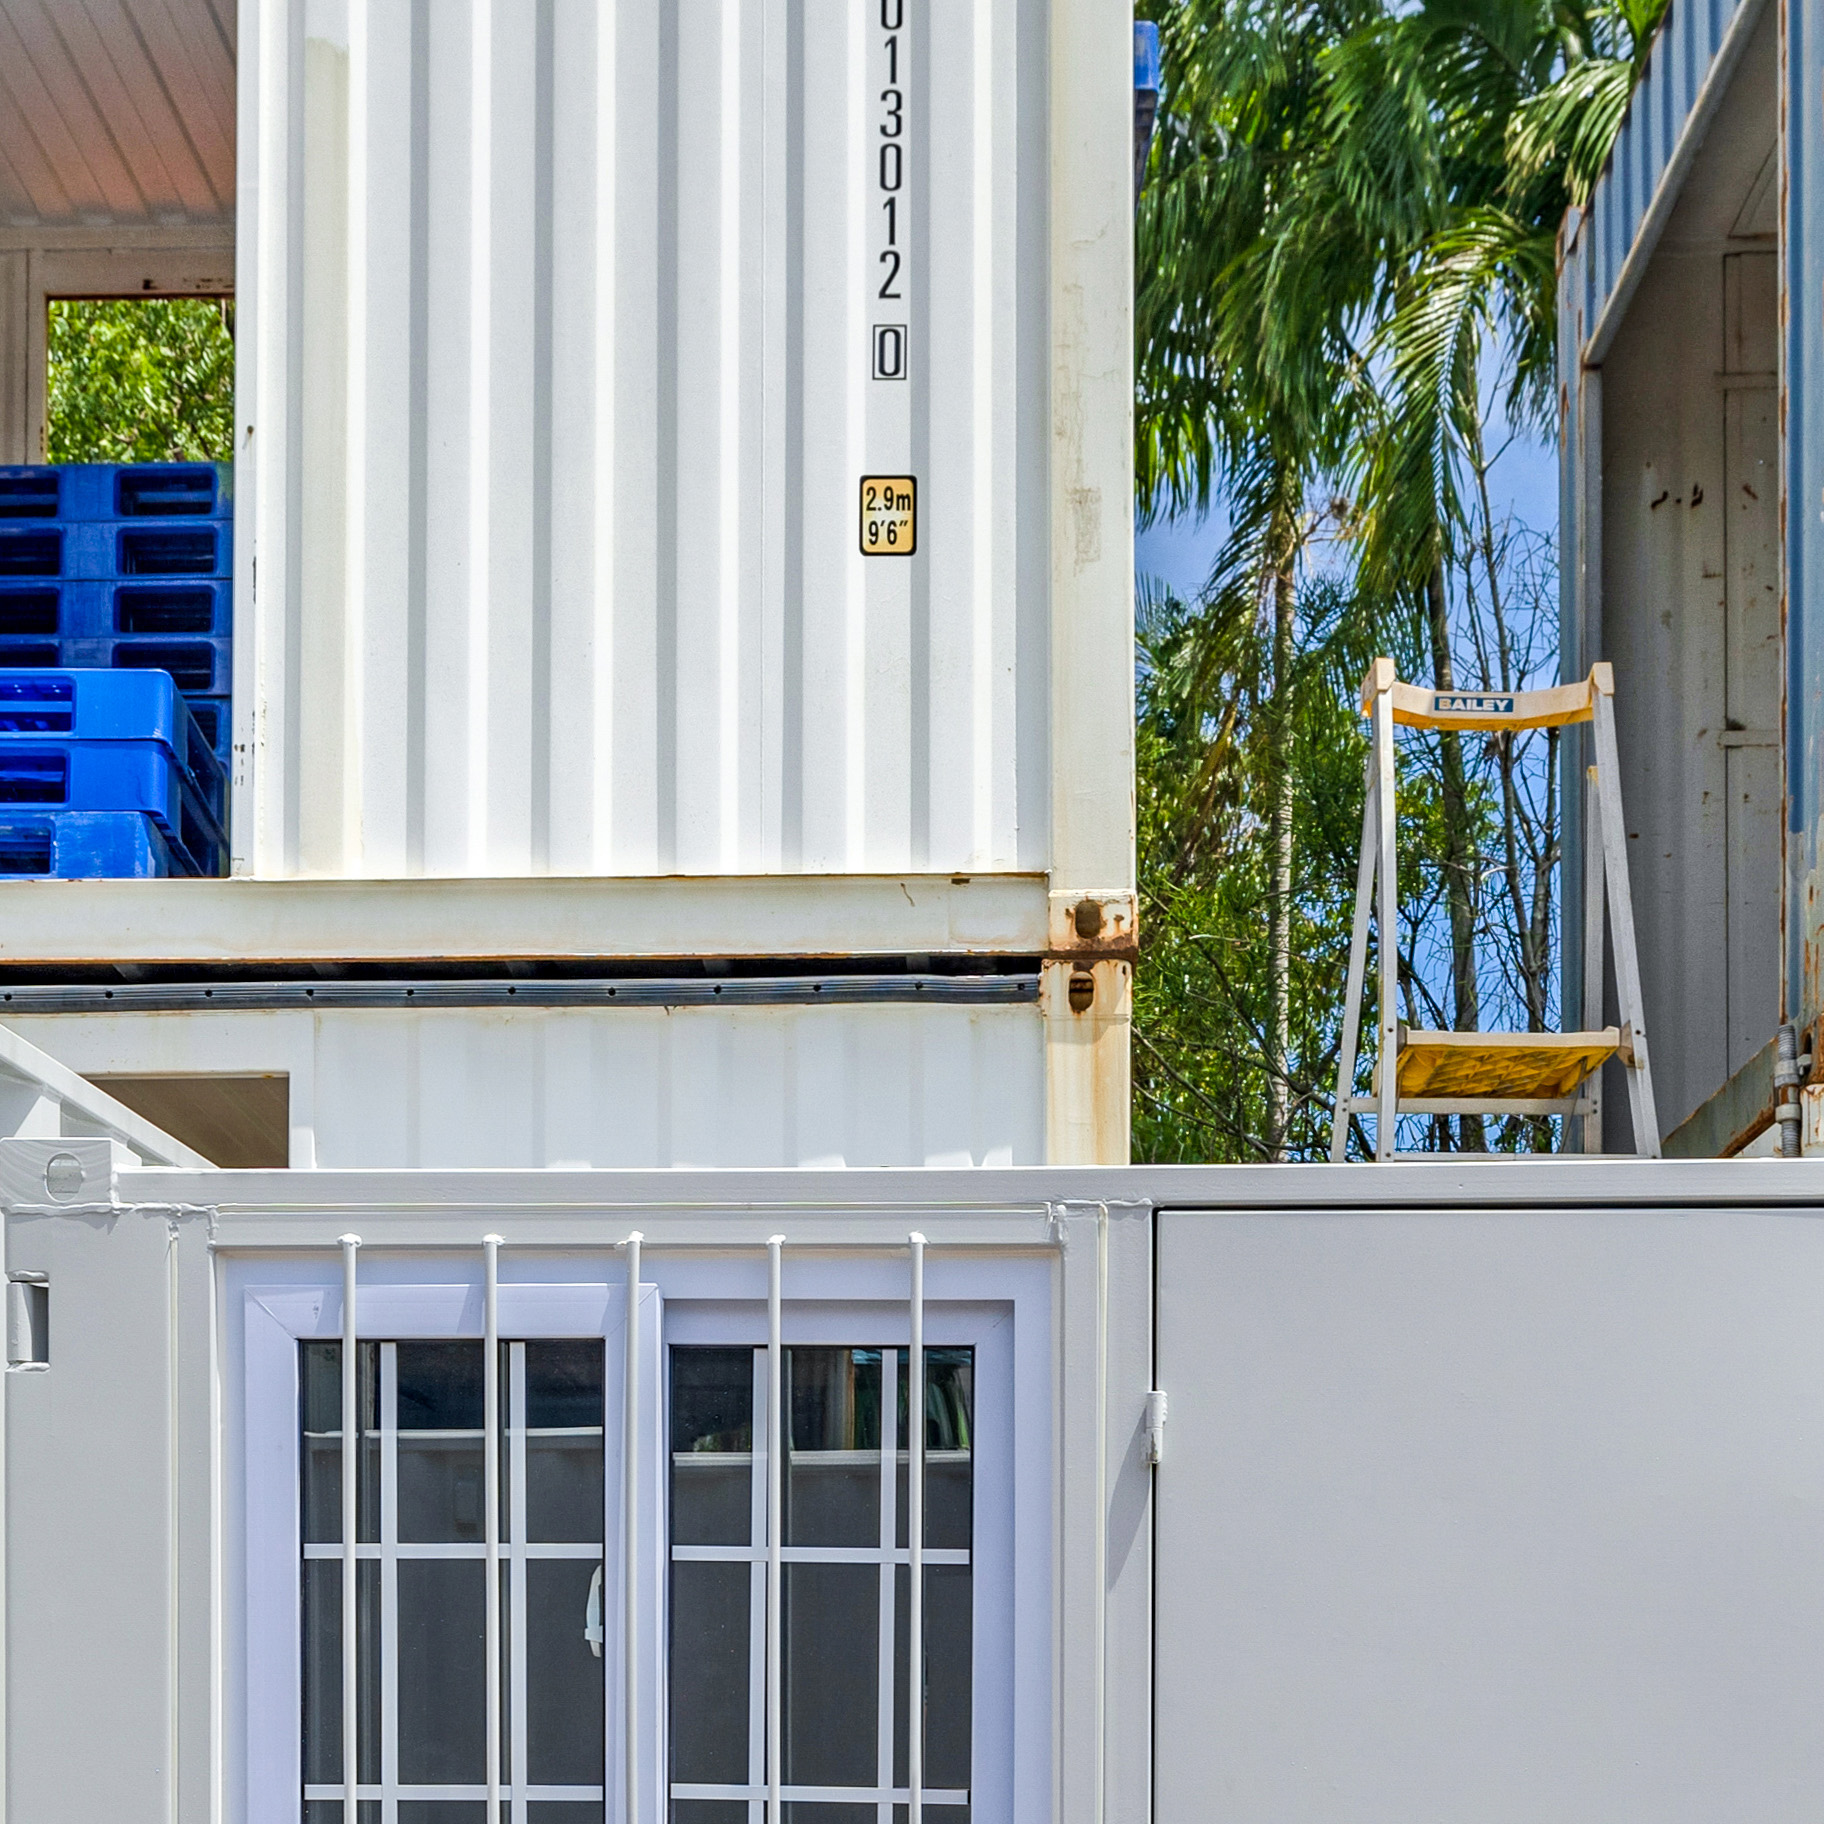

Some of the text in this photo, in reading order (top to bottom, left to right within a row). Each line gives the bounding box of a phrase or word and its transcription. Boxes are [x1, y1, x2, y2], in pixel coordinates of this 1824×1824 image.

[877, 327, 903, 378] 0
[866, 486, 912, 511] 2.9m
[1438, 698, 1509, 711] BAILEY
